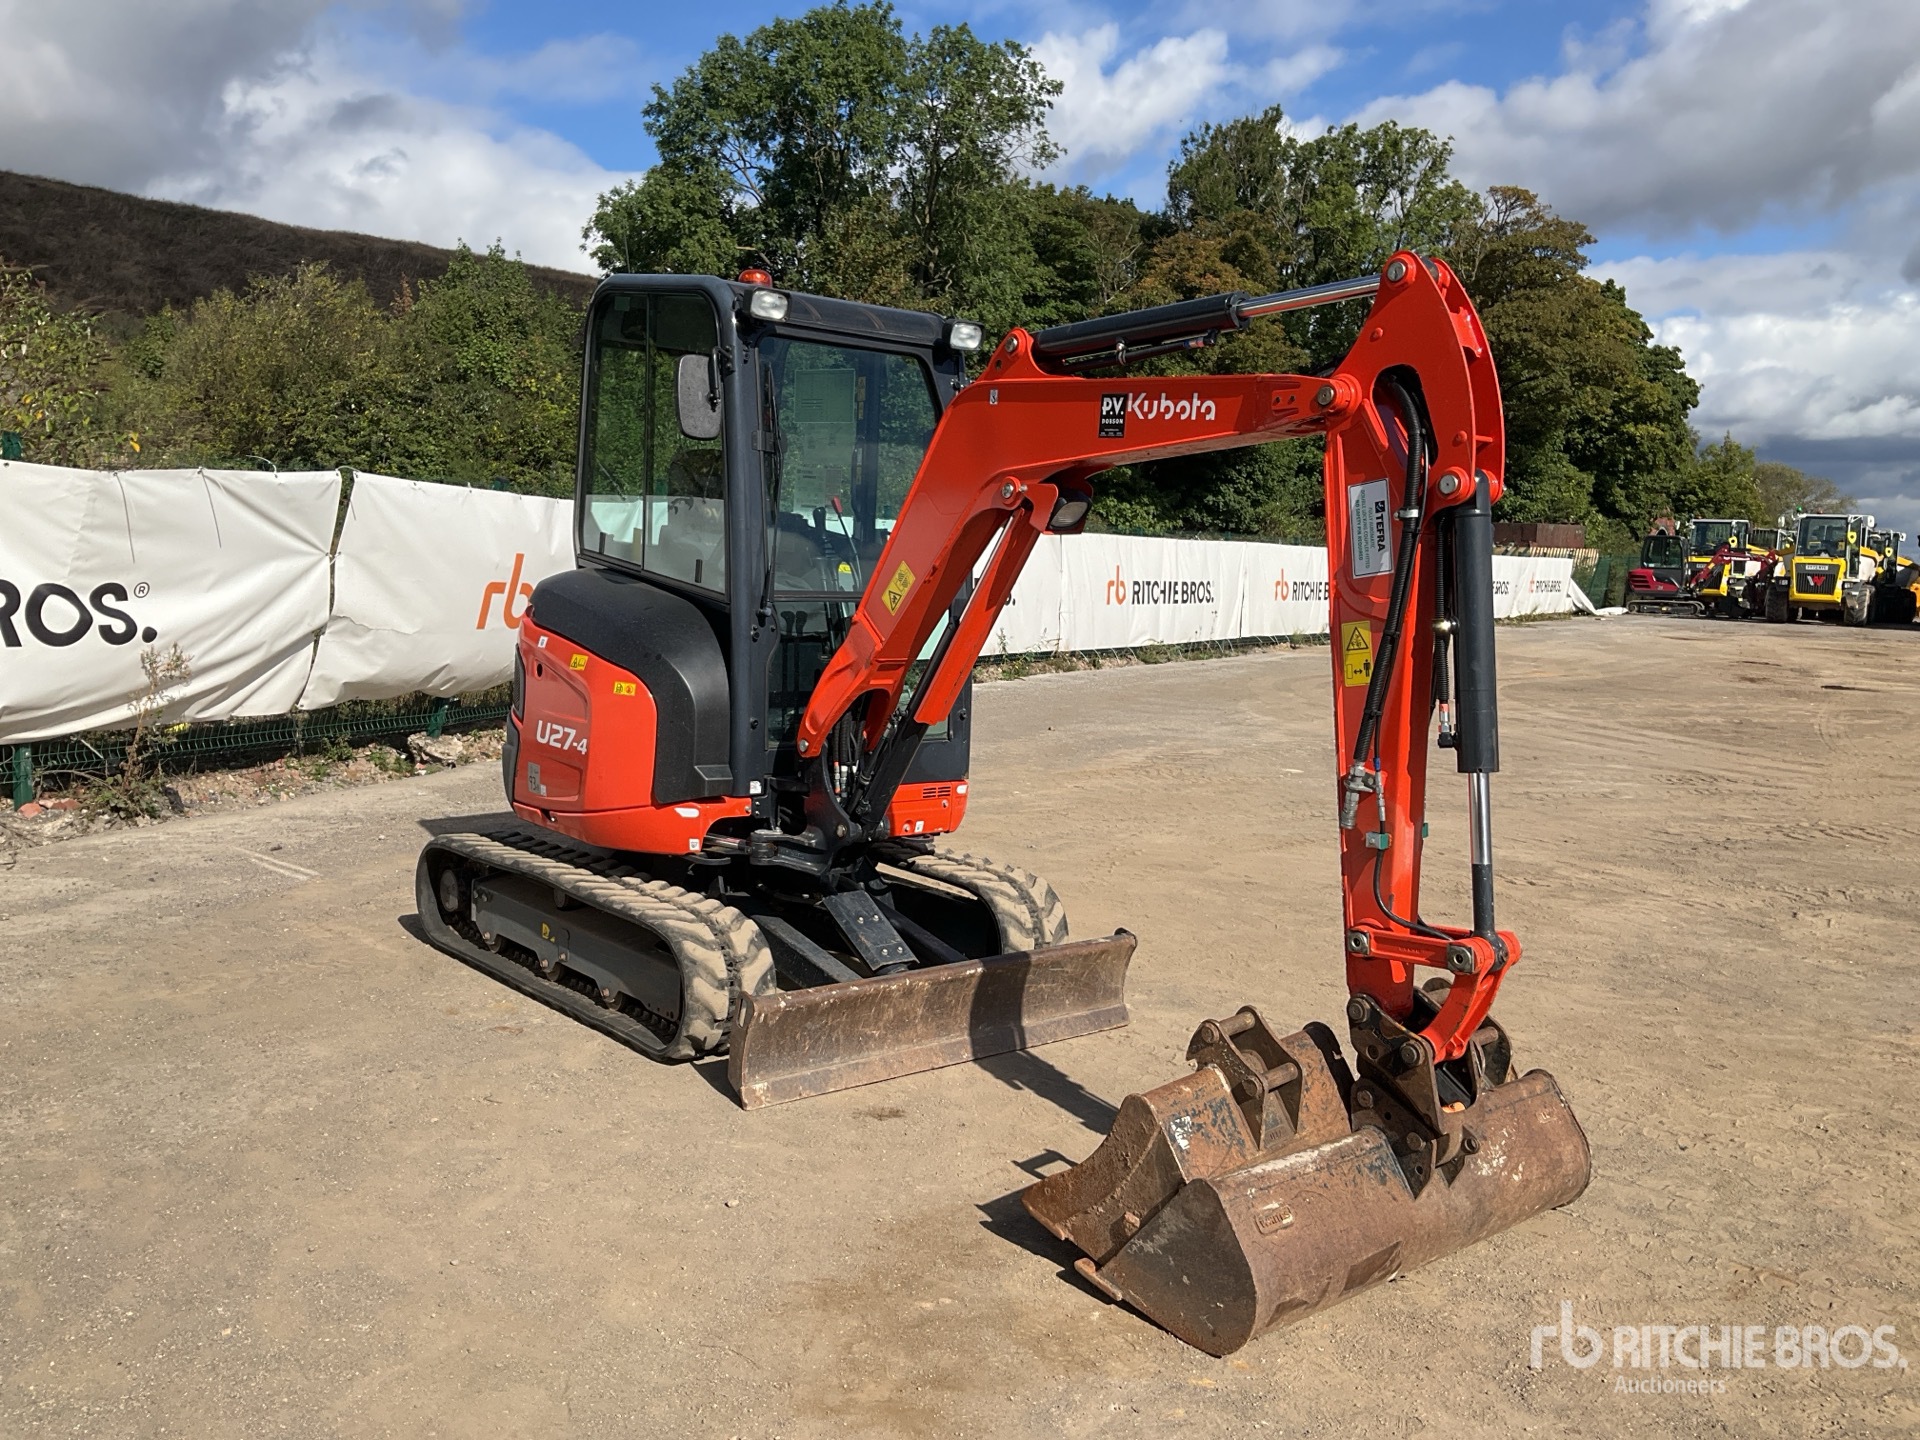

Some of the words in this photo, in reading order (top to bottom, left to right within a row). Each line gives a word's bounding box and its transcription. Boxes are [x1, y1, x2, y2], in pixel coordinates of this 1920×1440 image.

[1102, 397, 1124, 415] P.V.
[1127, 392, 1216, 421] Kubota
[1375, 513, 1385, 552] TEFRA
[476, 553, 534, 629] rb
[1106, 565, 1127, 605] rb
[1131, 580, 1179, 605] RITCHIE
[1181, 580, 1214, 604] BROS.
[1274, 568, 1289, 602] rb
[1291, 581, 1323, 601] RITCHIE
[536, 720, 588, 755] U27-4
